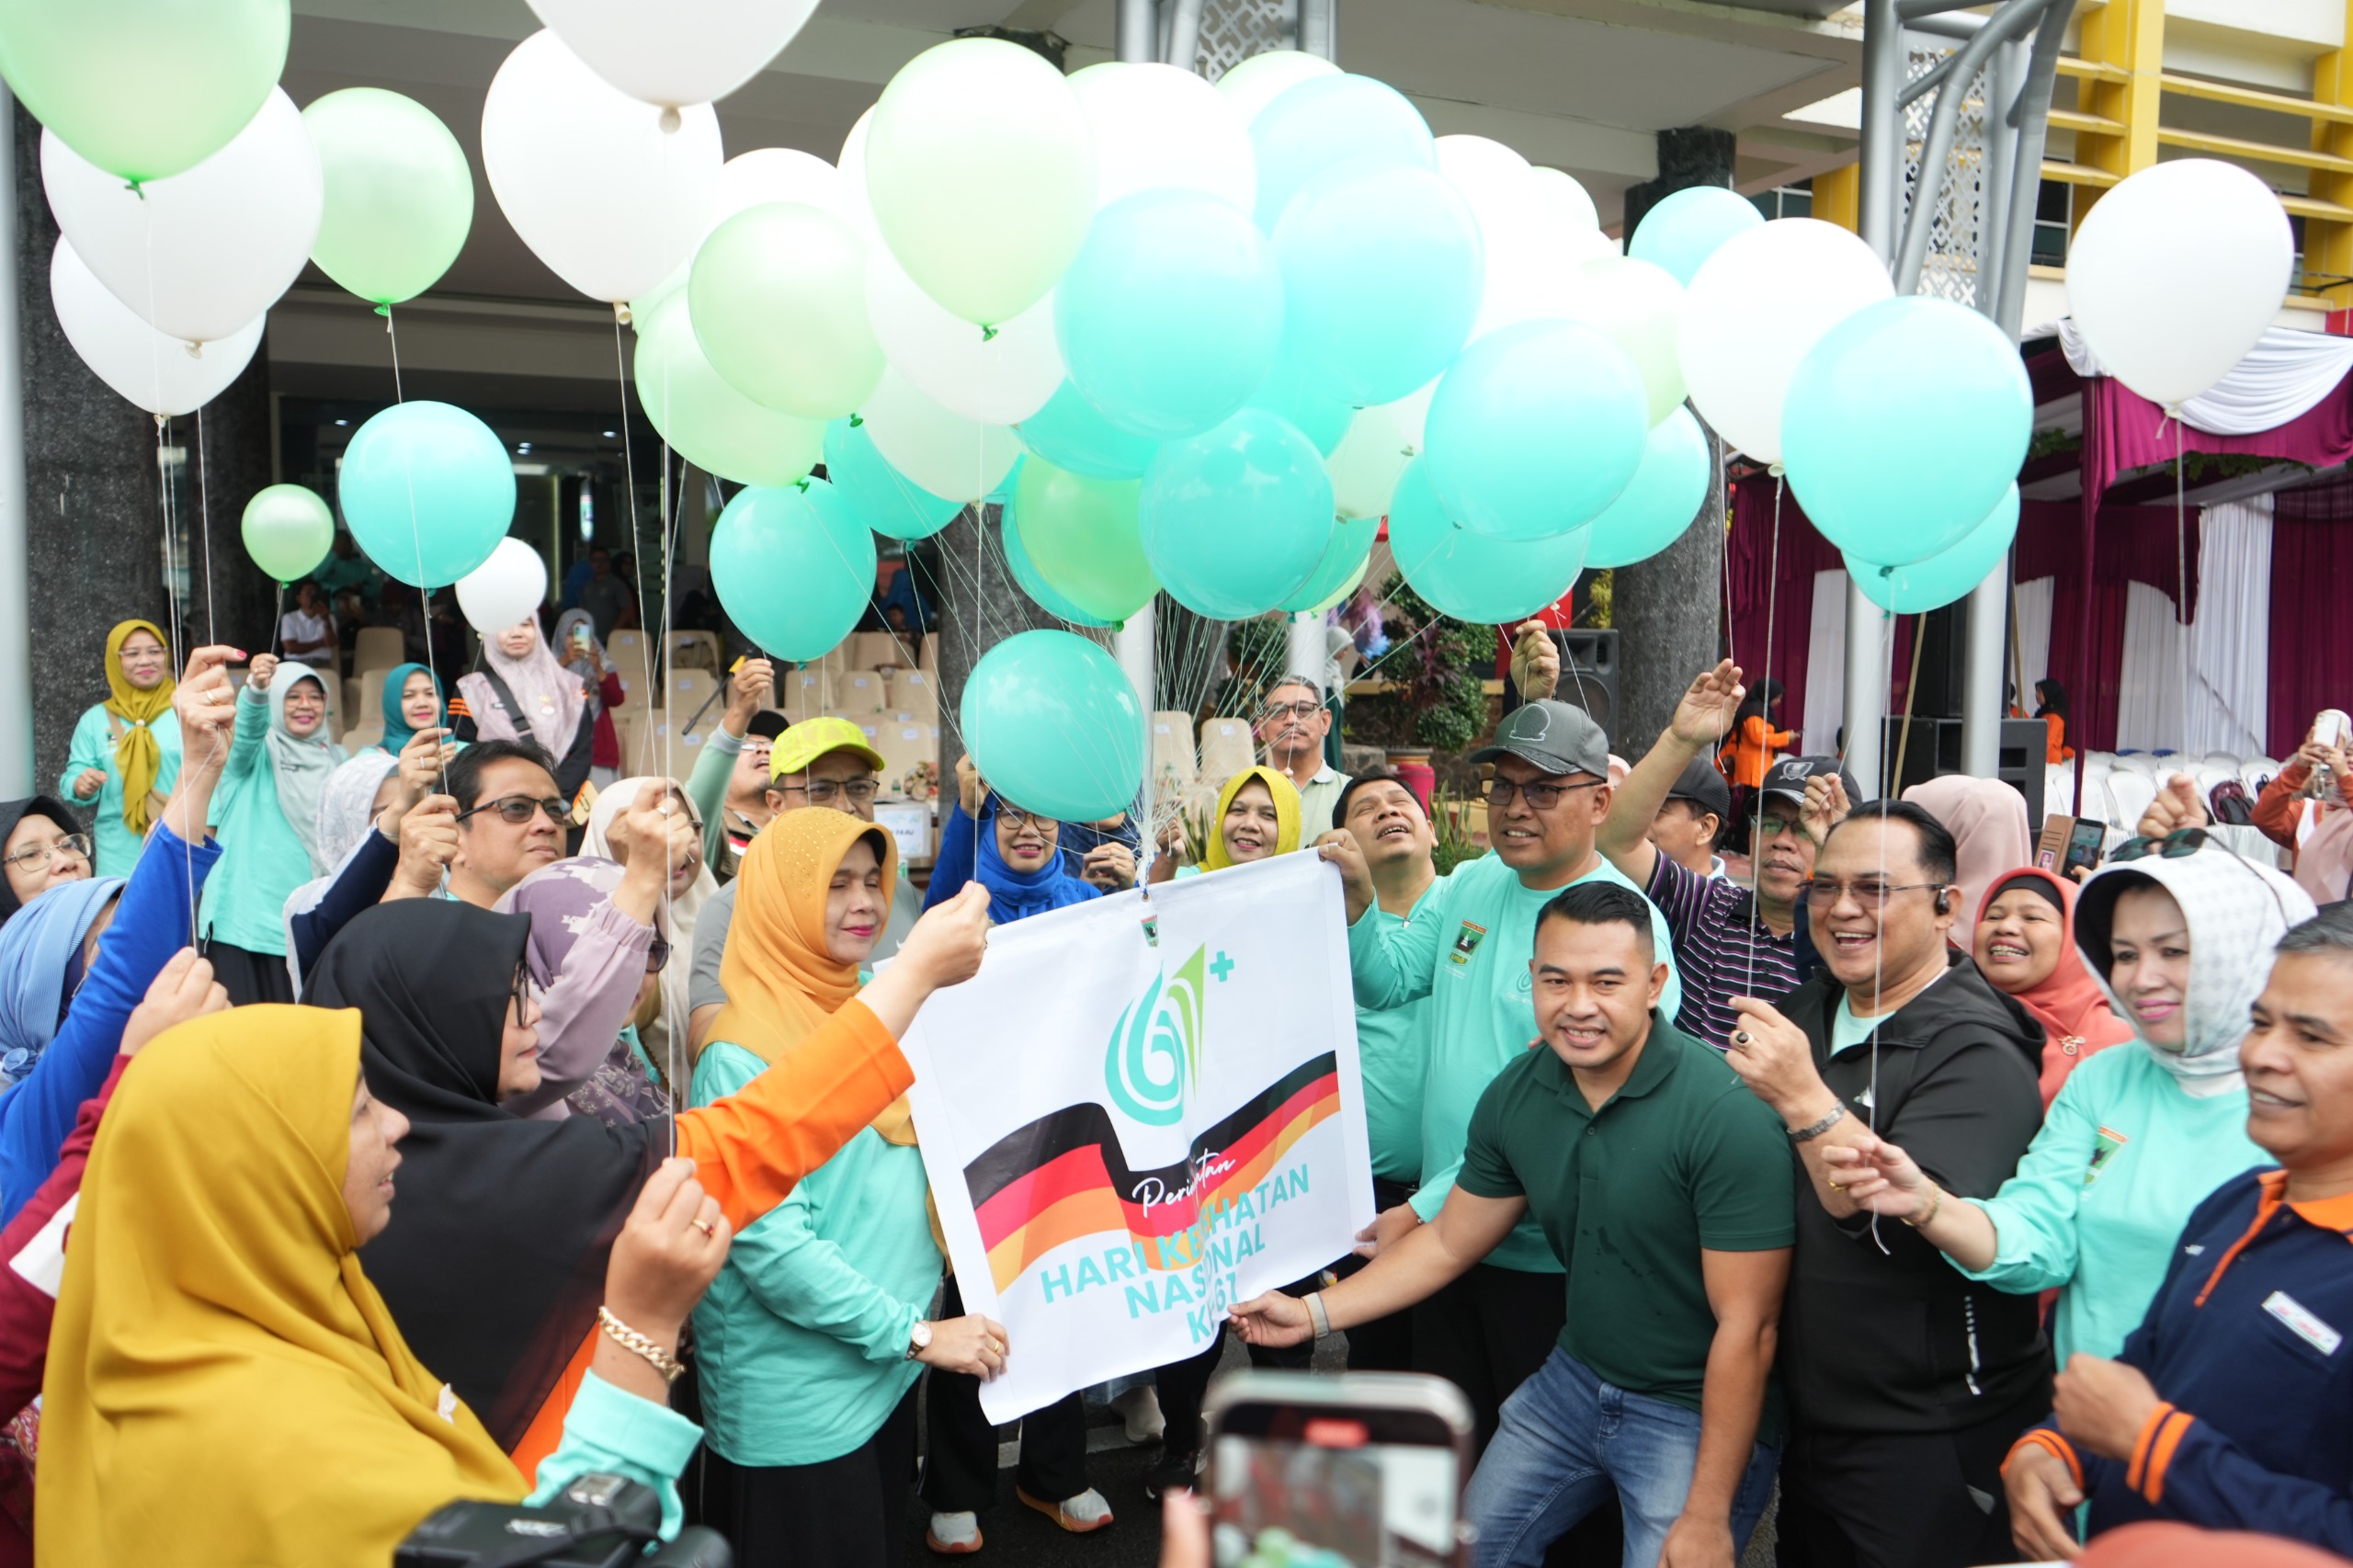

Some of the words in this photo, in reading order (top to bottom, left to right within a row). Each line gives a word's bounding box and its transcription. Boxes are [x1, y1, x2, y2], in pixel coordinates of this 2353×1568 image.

[1040, 1242, 1149, 1303] HARI
[1155, 1163, 1310, 1269] KEEHATAN
[1124, 1223, 1266, 1319] NASONAL
